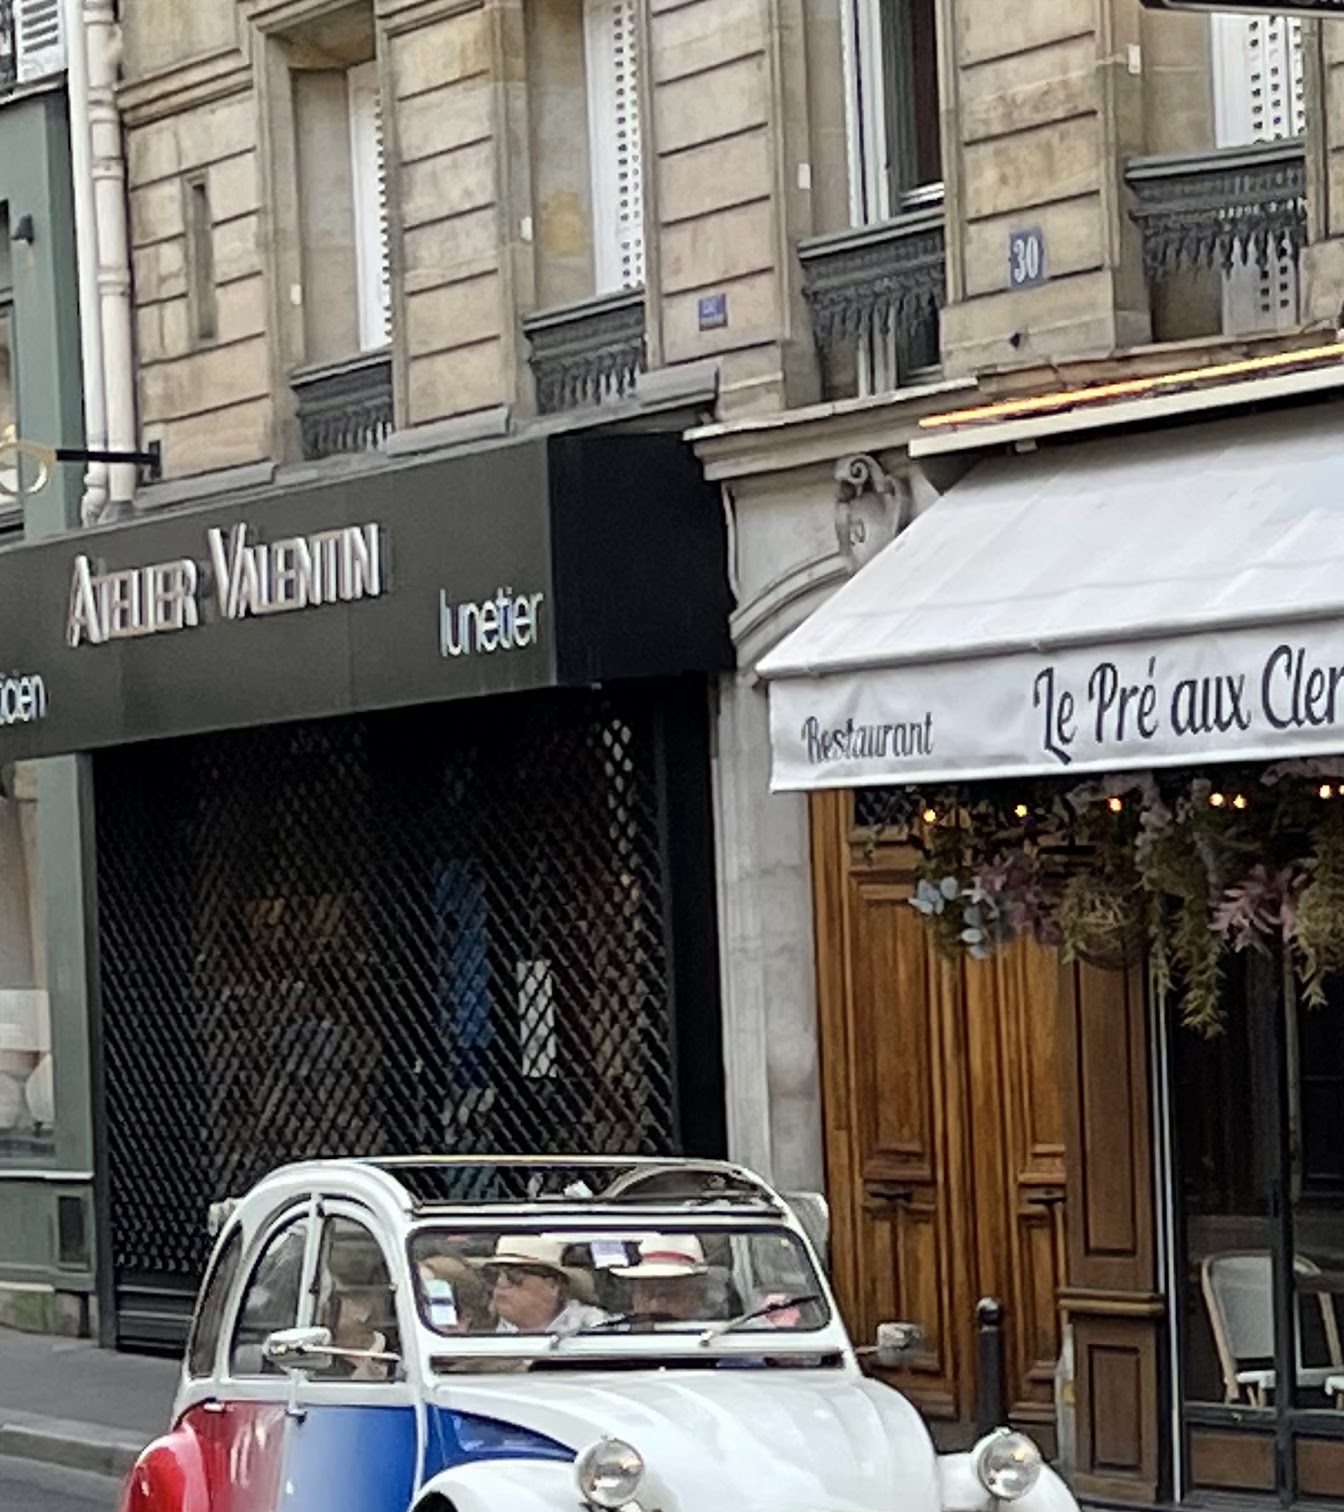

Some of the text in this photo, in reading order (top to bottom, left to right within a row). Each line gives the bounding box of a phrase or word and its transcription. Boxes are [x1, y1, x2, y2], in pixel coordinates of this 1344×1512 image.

[1013, 235, 1039, 283] 30
[440, 586, 544, 657] lunetier
[801, 711, 935, 765] Restaurant
[1033, 667, 1077, 766] Le
[1088, 656, 1159, 743] Pré
[1170, 674, 1251, 737] aux
